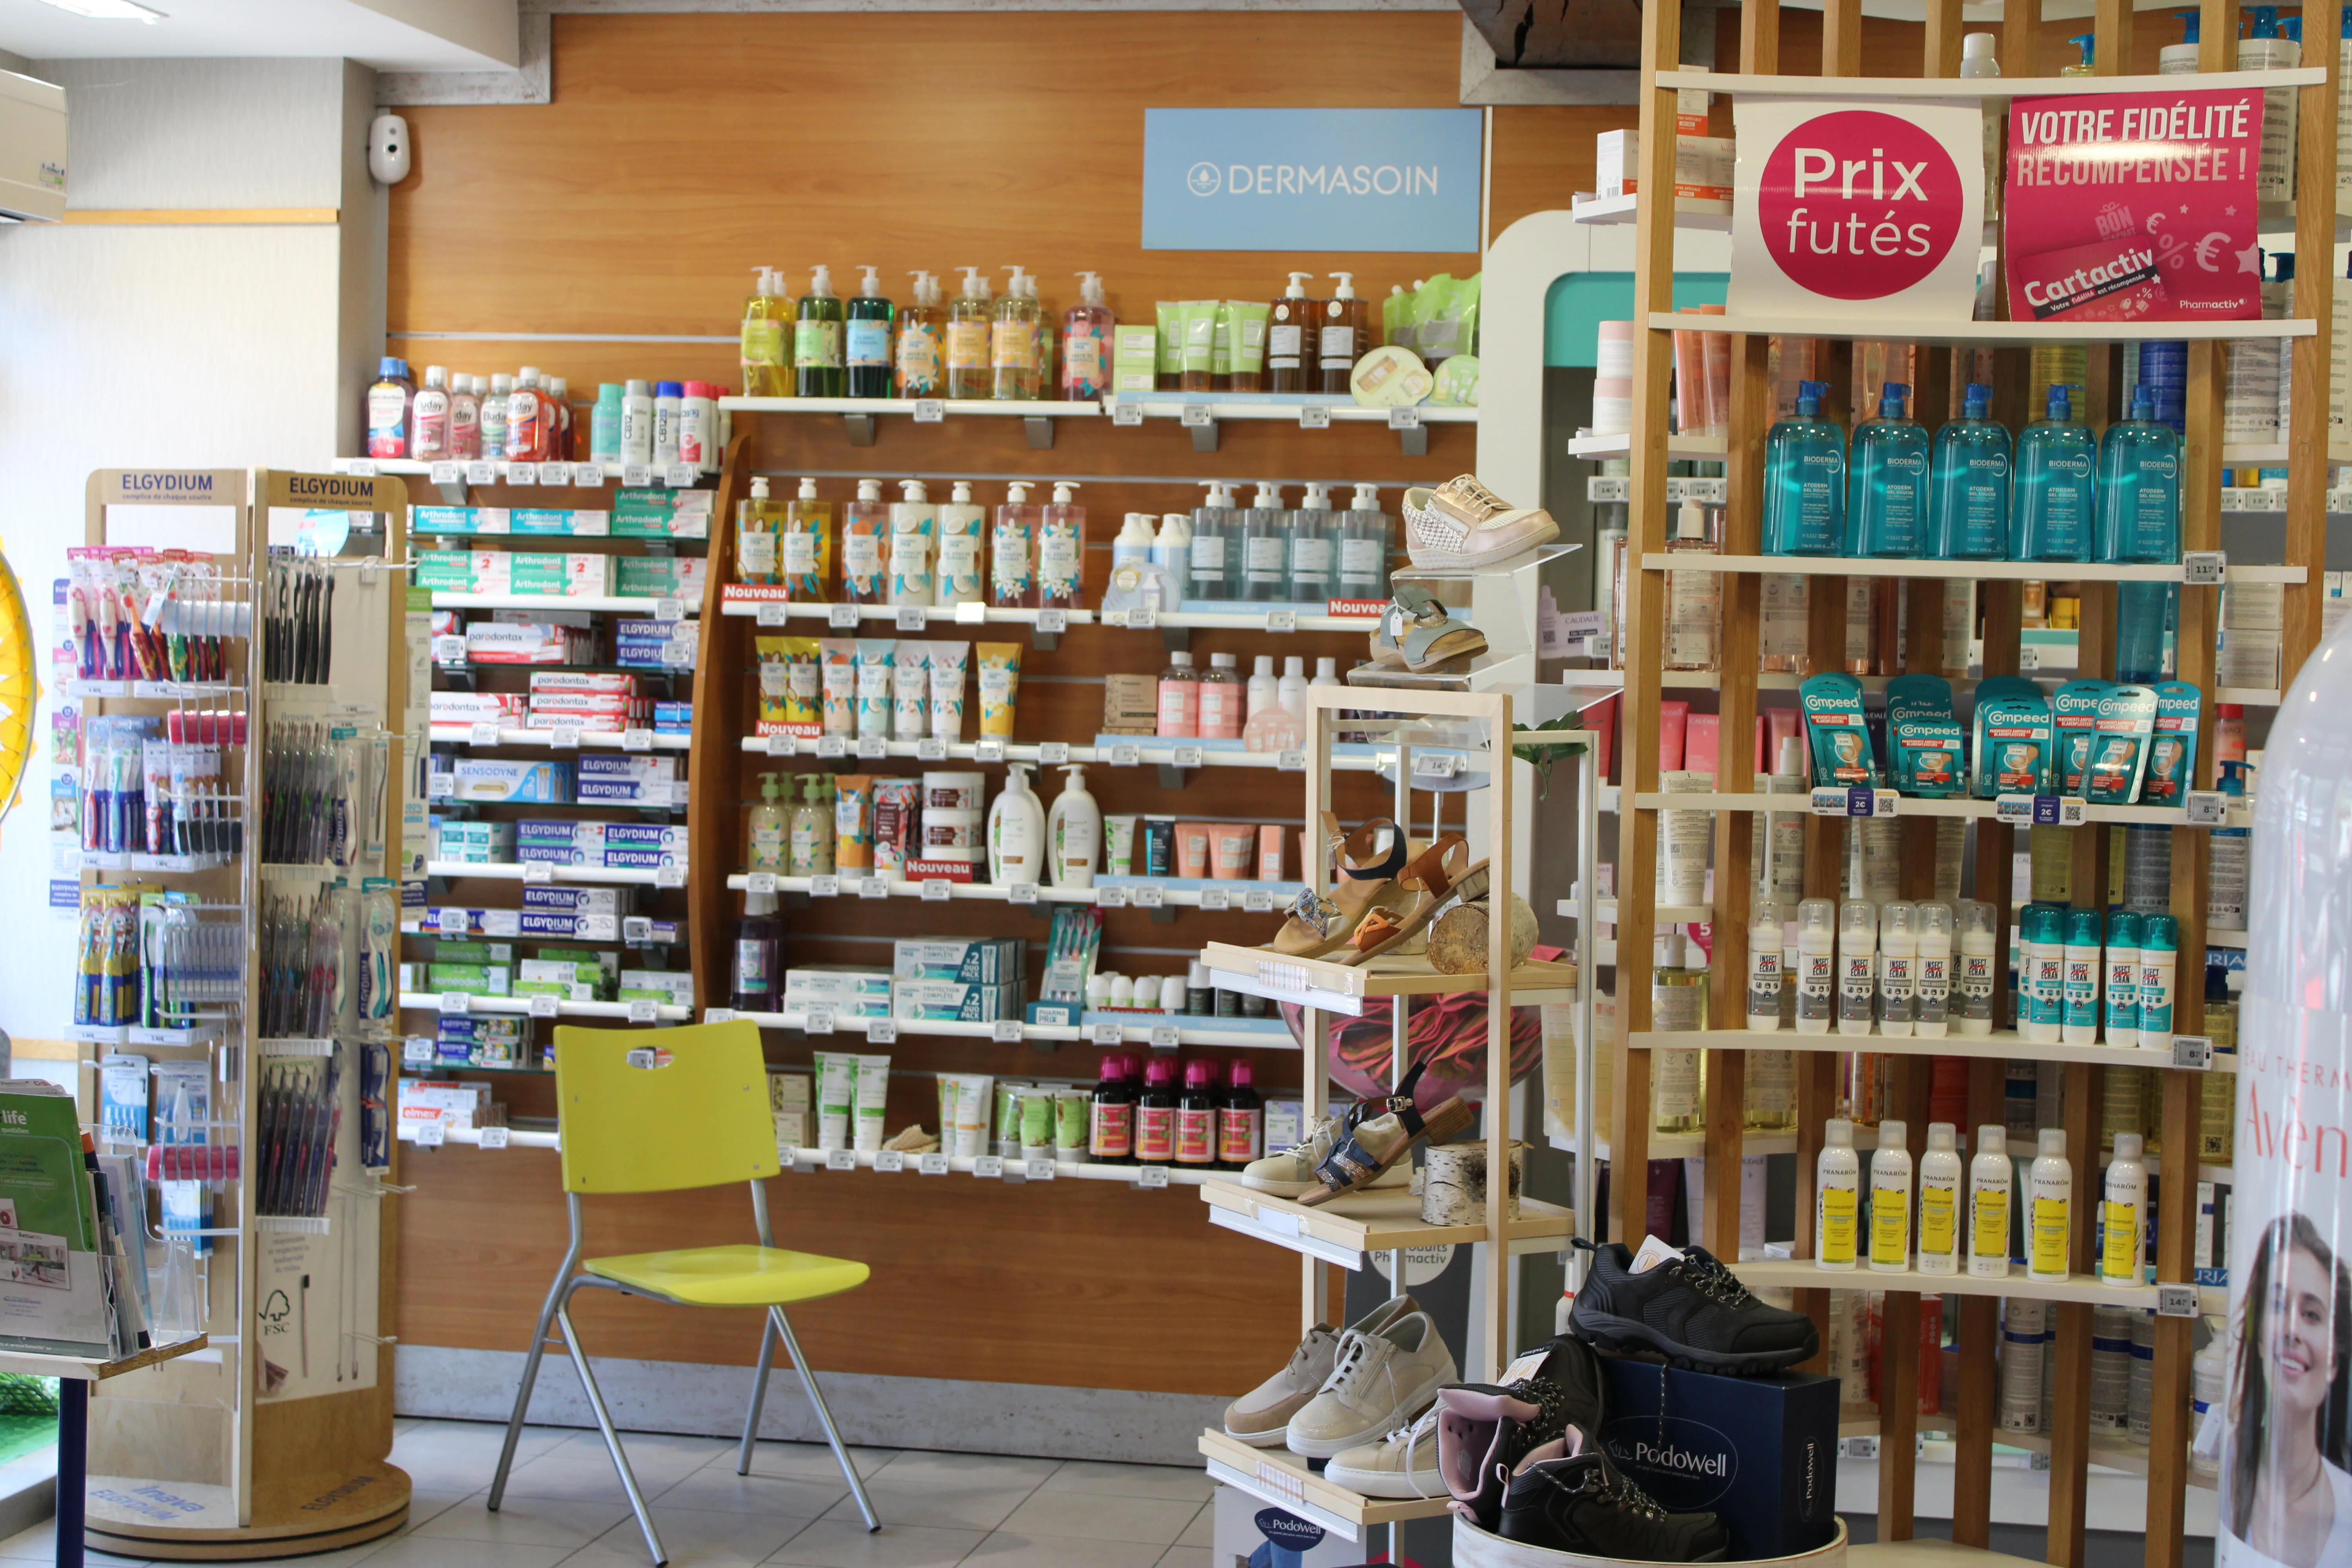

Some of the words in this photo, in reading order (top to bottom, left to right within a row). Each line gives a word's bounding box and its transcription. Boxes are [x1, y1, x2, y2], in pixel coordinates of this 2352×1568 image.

[2021, 109, 2114, 144] VOTRE
[2122, 98, 2250, 140] FIDÉLITÉ
[1794, 147, 1929, 201] Prix
[1229, 165, 1437, 195] DERMASOIN
[2095, 206, 2134, 237] BON
[1787, 208, 1930, 258] futés
[2024, 248, 2153, 306] Cartactiv
[2050, 299, 2070, 311] Votre
[2071, 289, 2094, 305] fidélité
[2098, 286, 2107, 295] est
[2108, 273, 2146, 292] récompensée
[2180, 299, 2238, 309] Pharmactiv
[122, 474, 212, 490] ELGYDIUM
[289, 477, 373, 497] ELGYDIUM
[619, 491, 666, 501] Arthrodont
[420, 510, 466, 519] Arthrodont
[515, 512, 562, 522] Arthrodont
[616, 514, 662, 524] Arthrodont
[420, 552, 467, 563] Arthrodont
[515, 555, 561, 566] Arthrodont
[421, 577, 467, 587] Arthrodont
[515, 579, 561, 590] Arthrodont
[724, 586, 786, 599] Nouveau
[1331, 601, 1385, 615] Nouvea
[620, 624, 670, 634] ELGYDIUM
[469, 633, 523, 642] parodontax
[537, 676, 590, 685] parodontax
[537, 696, 588, 706] parodontax
[1806, 694, 1859, 710] Compeed
[2056, 694, 2098, 711] Compe
[2098, 698, 2156, 715] Compeed
[2158, 698, 2198, 710] mpeed
[281, 712, 314, 721] Brosses
[534, 717, 585, 726] parodontax
[1989, 711, 2049, 725] Compeed
[758, 722, 820, 735] Nouveau
[1900, 724, 1960, 736] Compeed
[583, 759, 631, 771] ELGYDIUM
[461, 767, 519, 777] SENSODYNE
[582, 785, 631, 796] ELGYDIUM
[521, 824, 571, 836] ELGYDIUM
[608, 828, 659, 840] ELGYDIUM
[519, 848, 569, 859] ELGYDIUM
[607, 852, 658, 864] ELGYDIUM
[907, 861, 969, 874] Nouveau
[526, 891, 575, 902] ELGYDIUM
[1760, 955, 1777, 963] INSECT
[1813, 958, 1829, 966] INSECT
[1851, 958, 1868, 967] INSECT
[1889, 960, 1907, 969] INSECT
[1969, 958, 1987, 967] INSECT
[1759, 964, 1776, 973] ECRAN
[1925, 961, 1943, 969] INSECT
[2042, 962, 2059, 970] INSECT
[2071, 963, 2088, 972] INSECT
[2112, 965, 2131, 974] INSECT
[1813, 967, 1828, 976] ECRAN
[1851, 968, 1867, 976] ECRAN
[1889, 970, 1906, 978] ECRAN
[1925, 971, 1942, 979] ECRAN
[1969, 968, 1985, 976] ECRAN
[2143, 968, 2159, 976] INSECT
[2276, 1056, 2352, 1091] THERM
[404, 1109, 437, 1119] elmex
[2243, 1079, 2348, 1178] Avèn
[1976, 1176, 2009, 1185] PRANARÔM
[1374, 1251, 1446, 1264] Phmactiv
[264, 1323, 290, 1336] FSC
[1636, 1442, 1726, 1477] PodoWell
[1806, 1443, 1815, 1499] PodoWell
[1274, 1519, 1321, 1534] PodoWell
